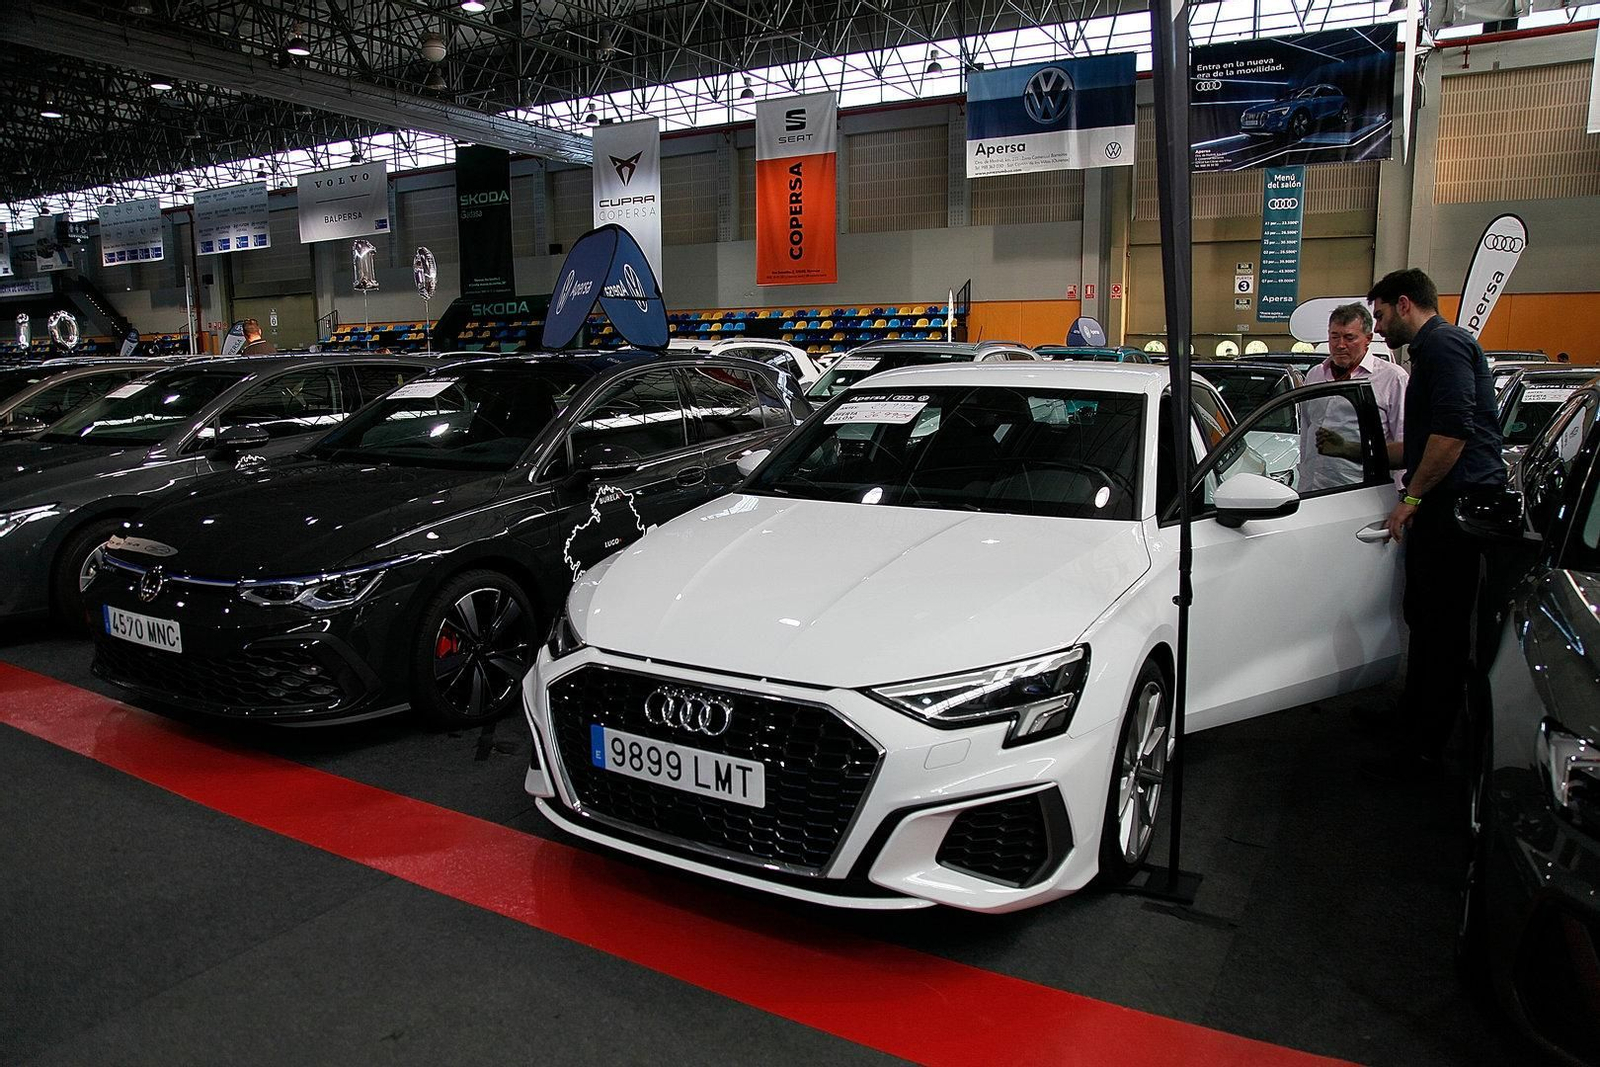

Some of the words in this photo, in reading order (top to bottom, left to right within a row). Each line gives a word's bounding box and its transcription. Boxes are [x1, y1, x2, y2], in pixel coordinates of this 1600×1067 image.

[1196, 64, 1221, 72] Entra
[1246, 57, 1274, 67] nueva
[1236, 63, 1285, 75] movilidad.
[778, 133, 814, 144] SEAT
[974, 142, 1026, 159] Apersa
[314, 172, 370, 189] VOLVO
[1267, 181, 1280, 189] del
[1280, 180, 1302, 189] salón
[1274, 173, 1296, 182] Menú
[598, 194, 656, 208] CUPRA
[324, 211, 364, 224] BALPERSA
[598, 206, 657, 221] COPERSA
[788, 161, 804, 261] COPERSA
[1240, 282, 1248, 291] 3
[1261, 295, 1293, 304] Apersa
[1465, 270, 1506, 335] persa
[112, 611, 144, 640] 4570
[146, 620, 177, 648] MNC
[610, 736, 683, 782] 9899
[693, 754, 754, 799] LMT
